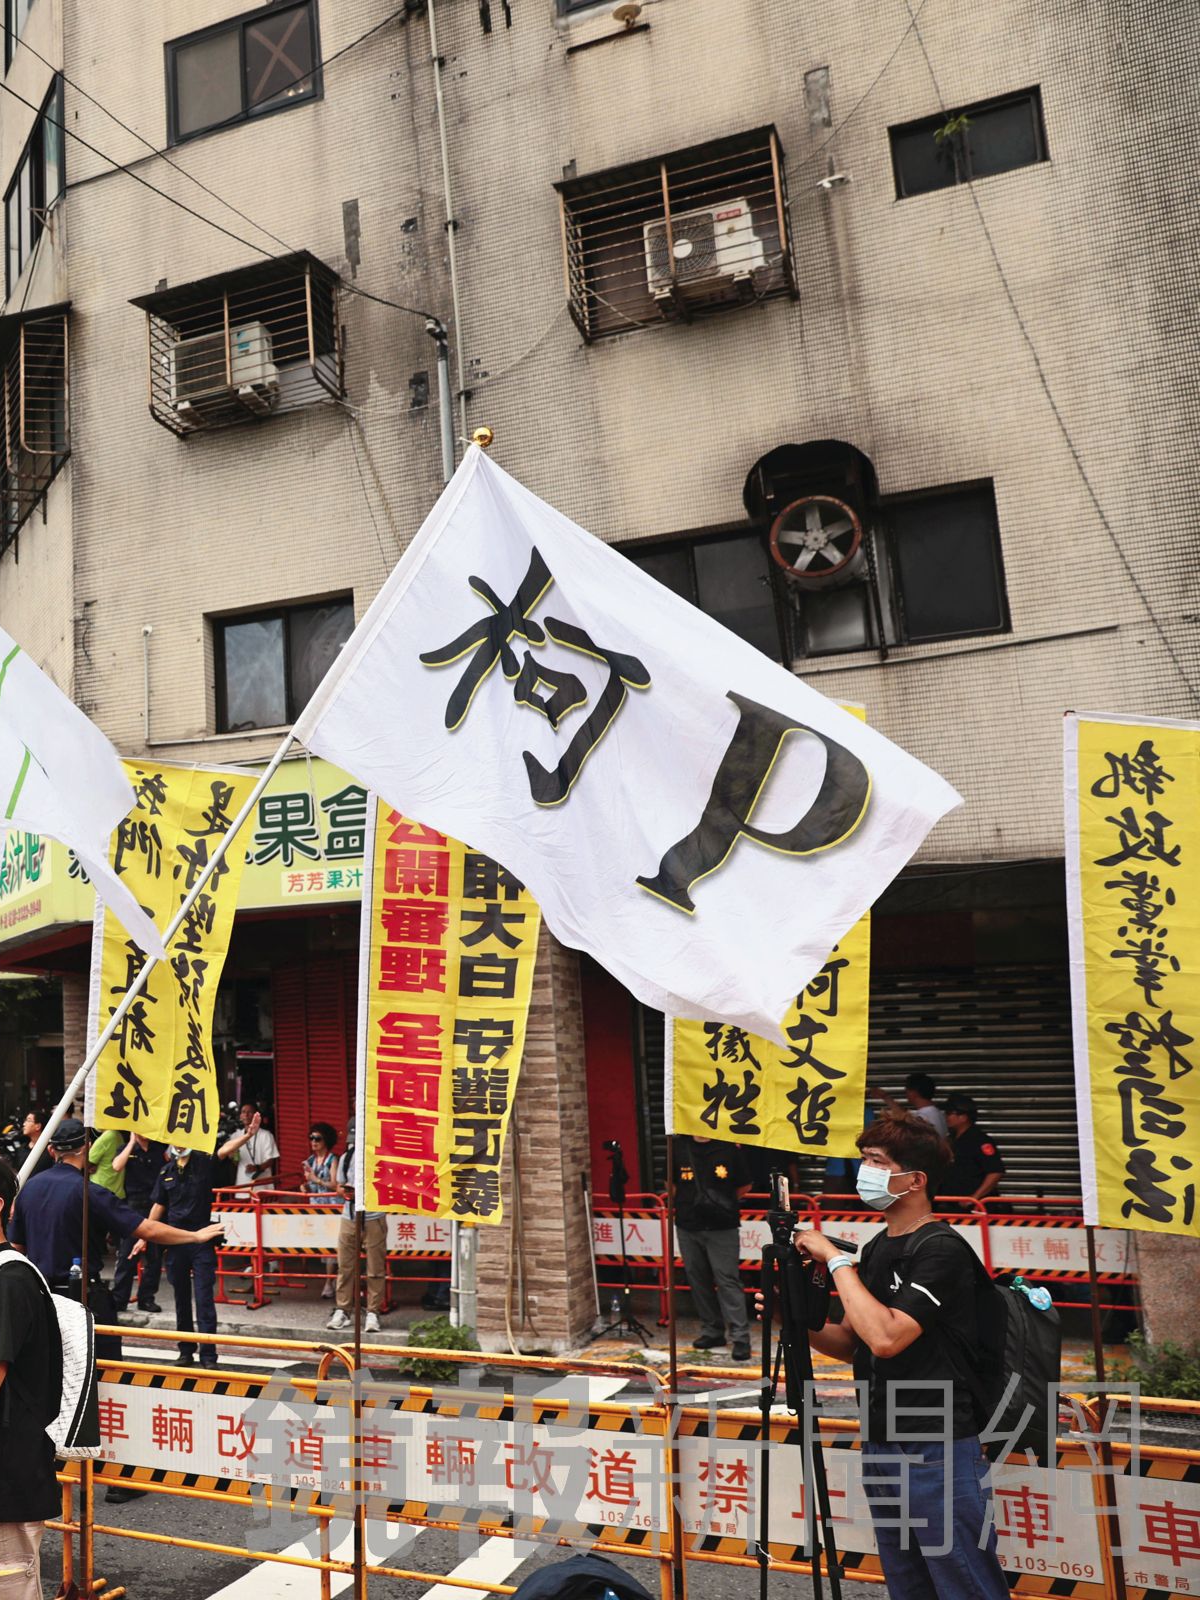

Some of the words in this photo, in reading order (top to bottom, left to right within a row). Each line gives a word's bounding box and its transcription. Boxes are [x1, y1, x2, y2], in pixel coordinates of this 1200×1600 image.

[419, 545, 874, 916] 柯P
[778, 944, 850, 1146] 柯文哲
[98, 1397, 330, 1472] 車輛改道
[362, 1424, 641, 1507] 車輛改道
[1014, 1555, 1095, 1578] 103-069
[1138, 1500, 1200, 1567] 車
